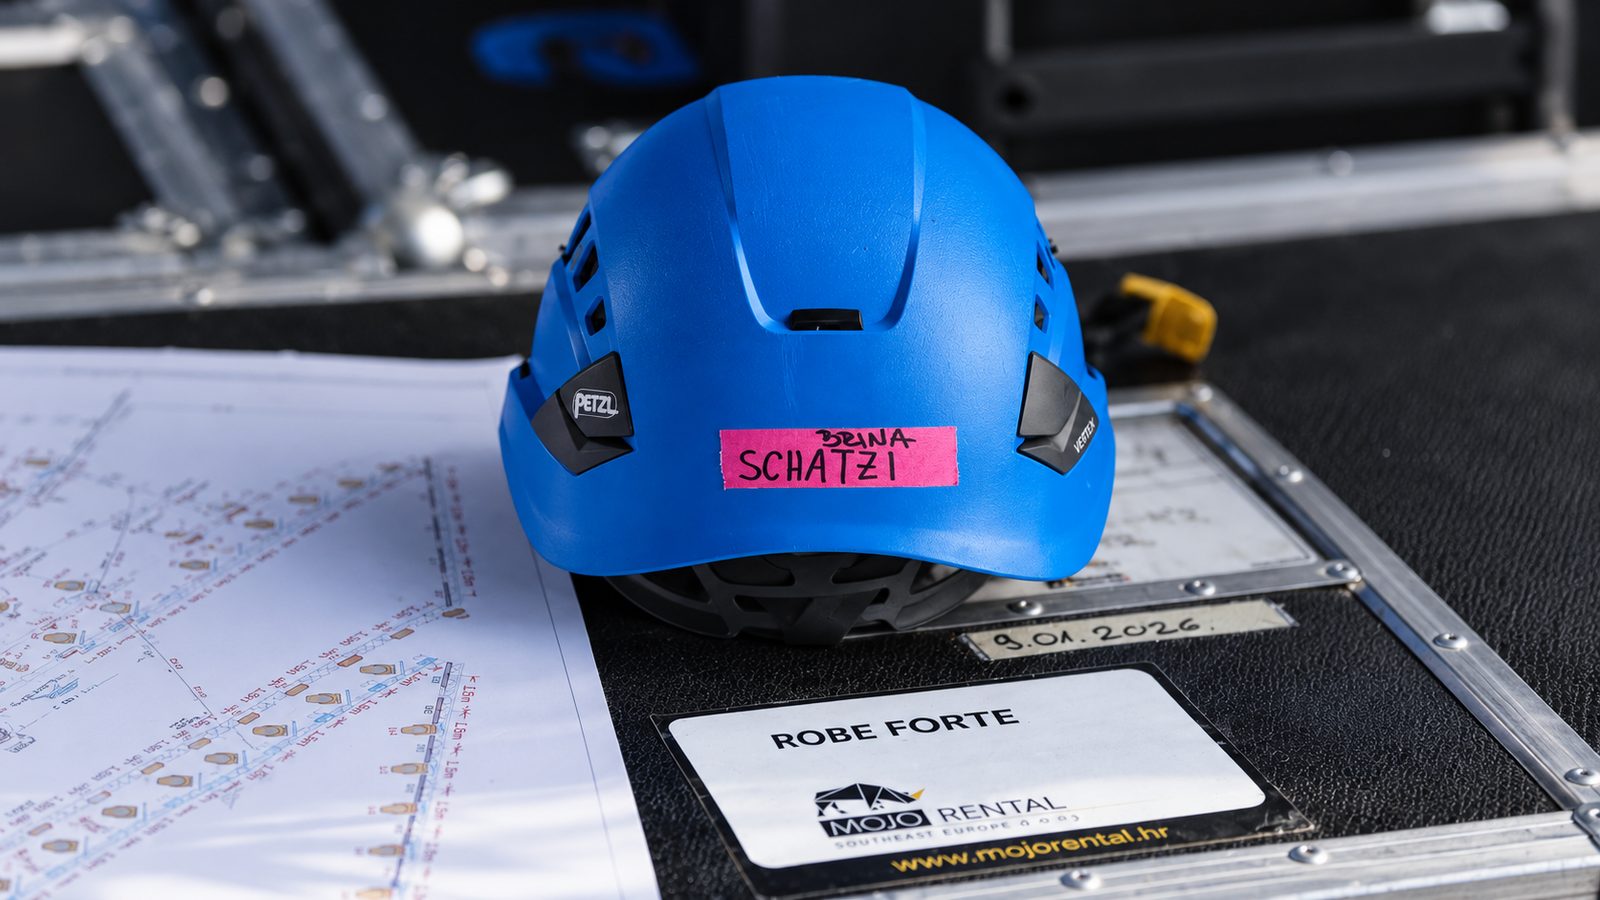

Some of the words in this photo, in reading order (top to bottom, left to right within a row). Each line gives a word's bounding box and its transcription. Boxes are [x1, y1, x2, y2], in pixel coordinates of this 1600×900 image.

[574, 392, 619, 419] PETZL
[815, 428, 917, 448] BRINA
[1073, 417, 1096, 453] VERTEX
[739, 449, 896, 484] SCHATZI
[770, 723, 878, 750] ROBE
[884, 708, 1020, 737] FORTE
[829, 811, 924, 836] MOJO
[937, 796, 1067, 822] RENTAL
[834, 830, 933, 849] SOUTHEAST
[943, 821, 1011, 837] EUROPE
[890, 824, 1170, 873] www.mojorental.hr
